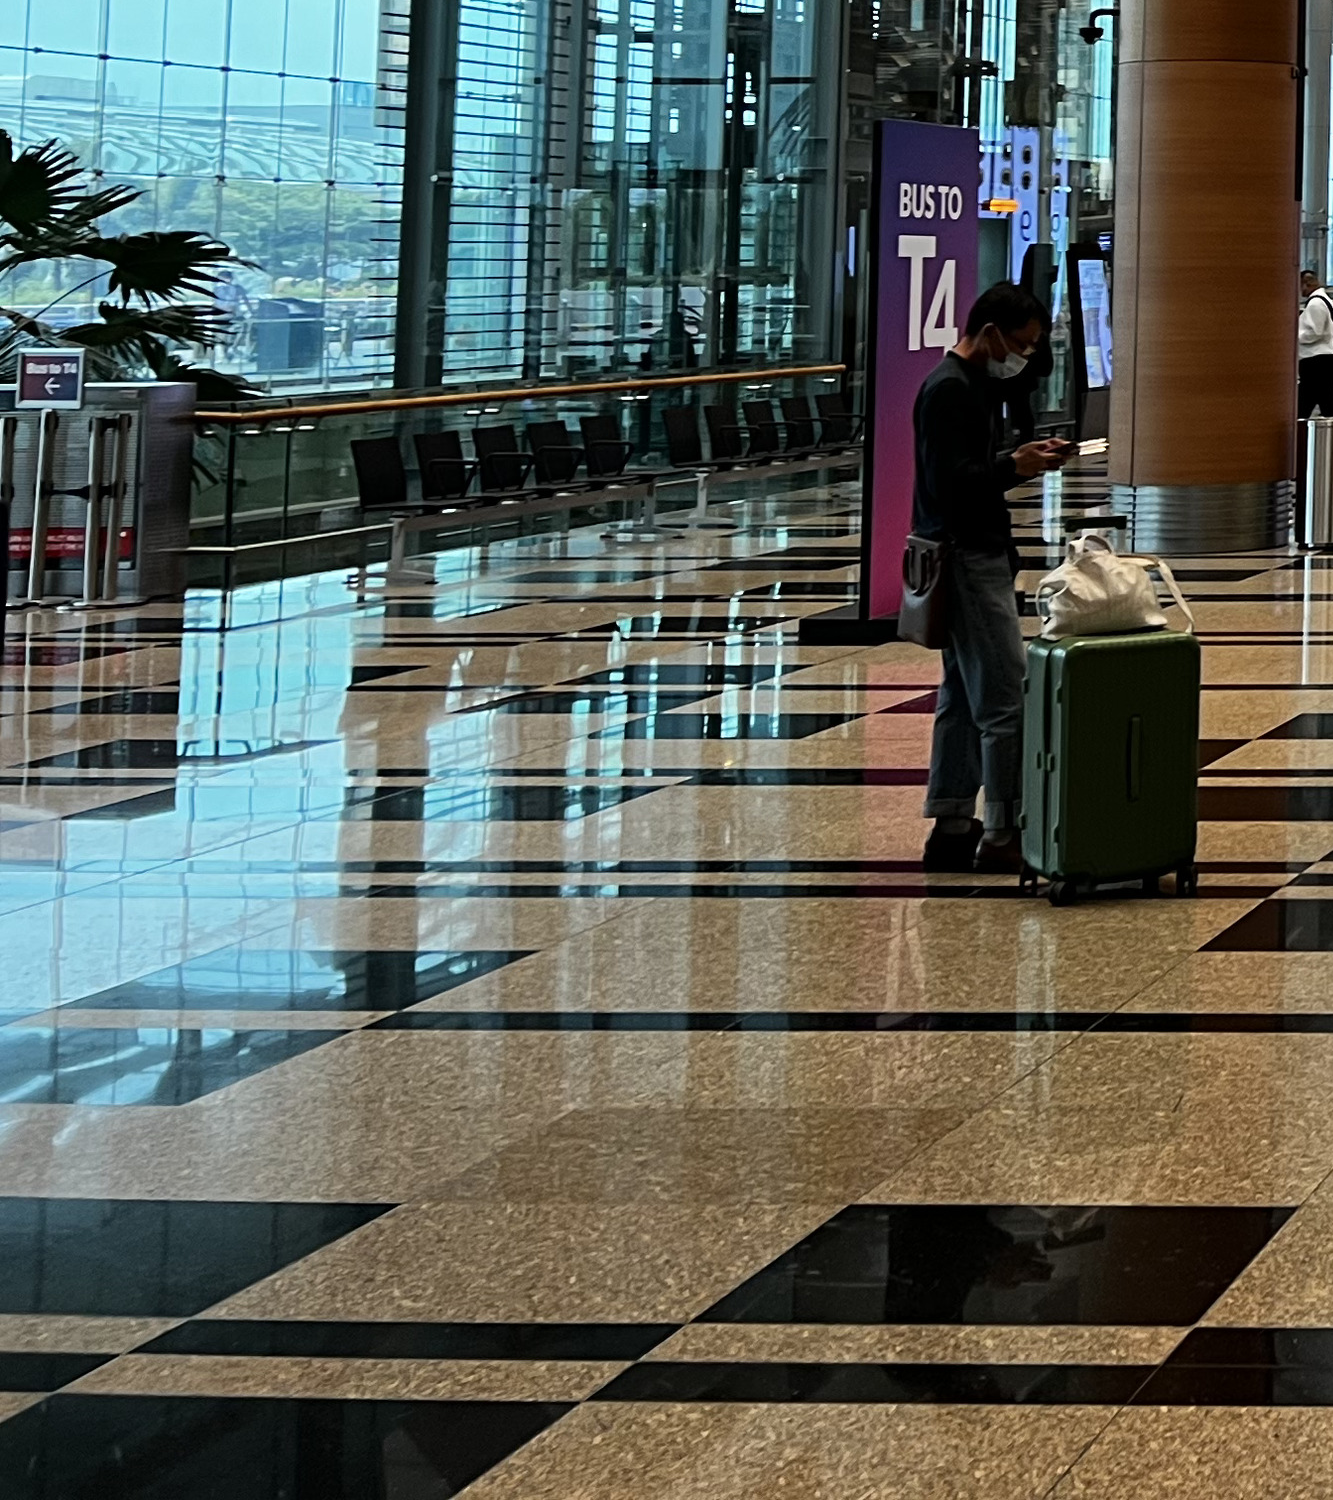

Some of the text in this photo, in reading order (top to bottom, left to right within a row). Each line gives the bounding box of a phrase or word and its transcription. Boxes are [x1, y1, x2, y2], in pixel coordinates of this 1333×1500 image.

[900, 182, 963, 220] BUS TO
[898, 234, 959, 357] T4
